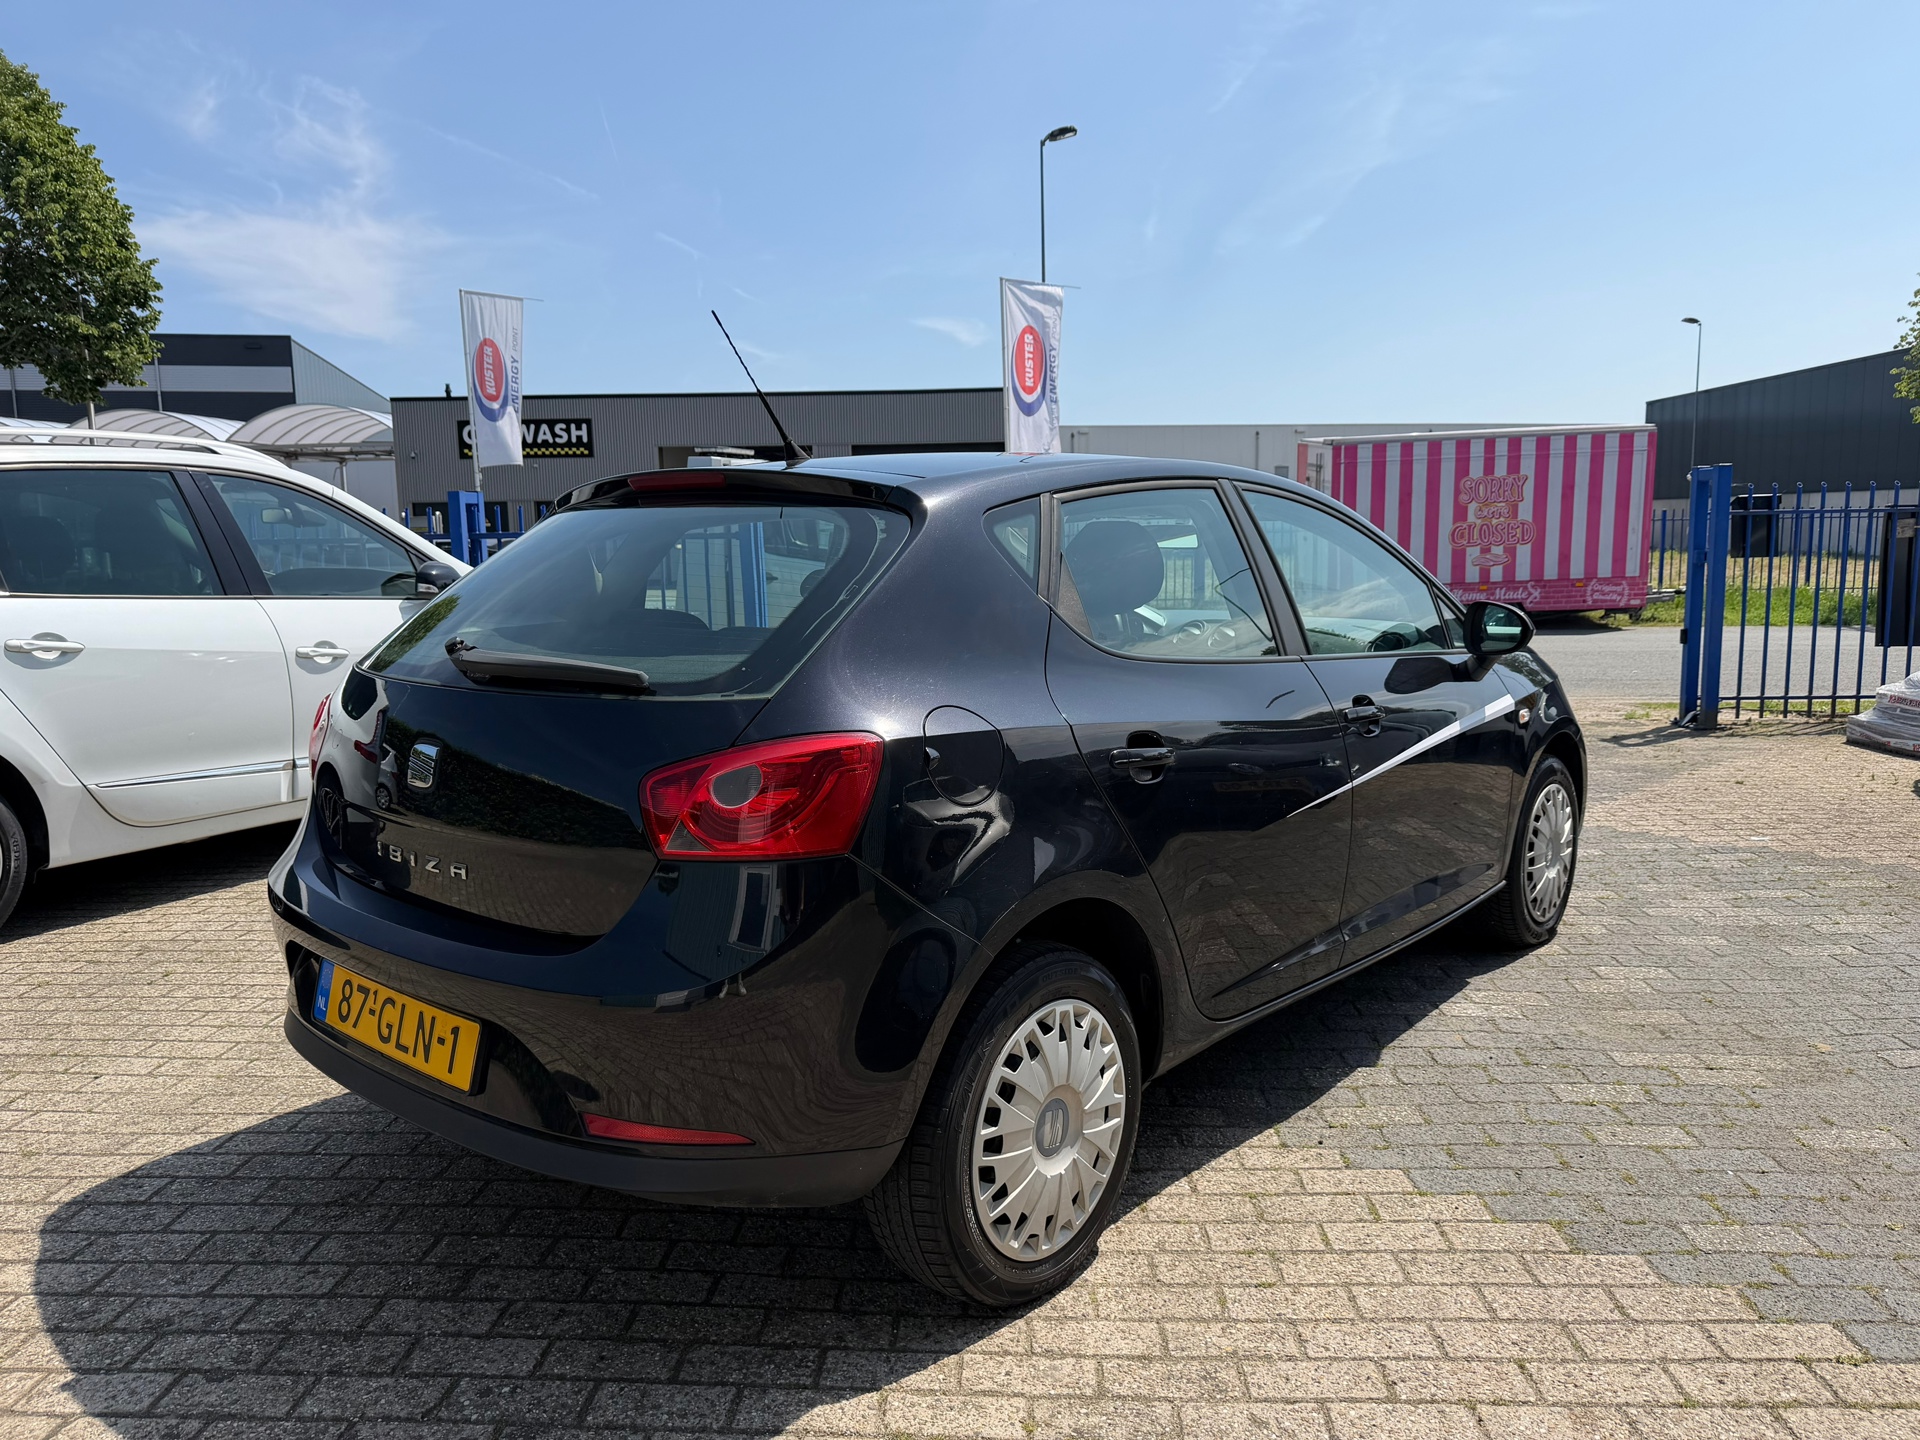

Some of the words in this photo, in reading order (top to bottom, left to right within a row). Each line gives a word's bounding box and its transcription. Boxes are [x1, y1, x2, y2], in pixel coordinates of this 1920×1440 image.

[483, 345, 497, 396] KUSTER
[1024, 333, 1034, 388] KUSTER
[1049, 344, 1058, 403] ENERGY
[1460, 474, 1528, 504] SORRY
[1449, 520, 1535, 547] CLOSED
[1490, 587, 1529, 600] Made
[377, 841, 467, 880] IBIZA
[317, 995, 327, 1011] NL
[337, 979, 460, 1074] 87-GLN-1
